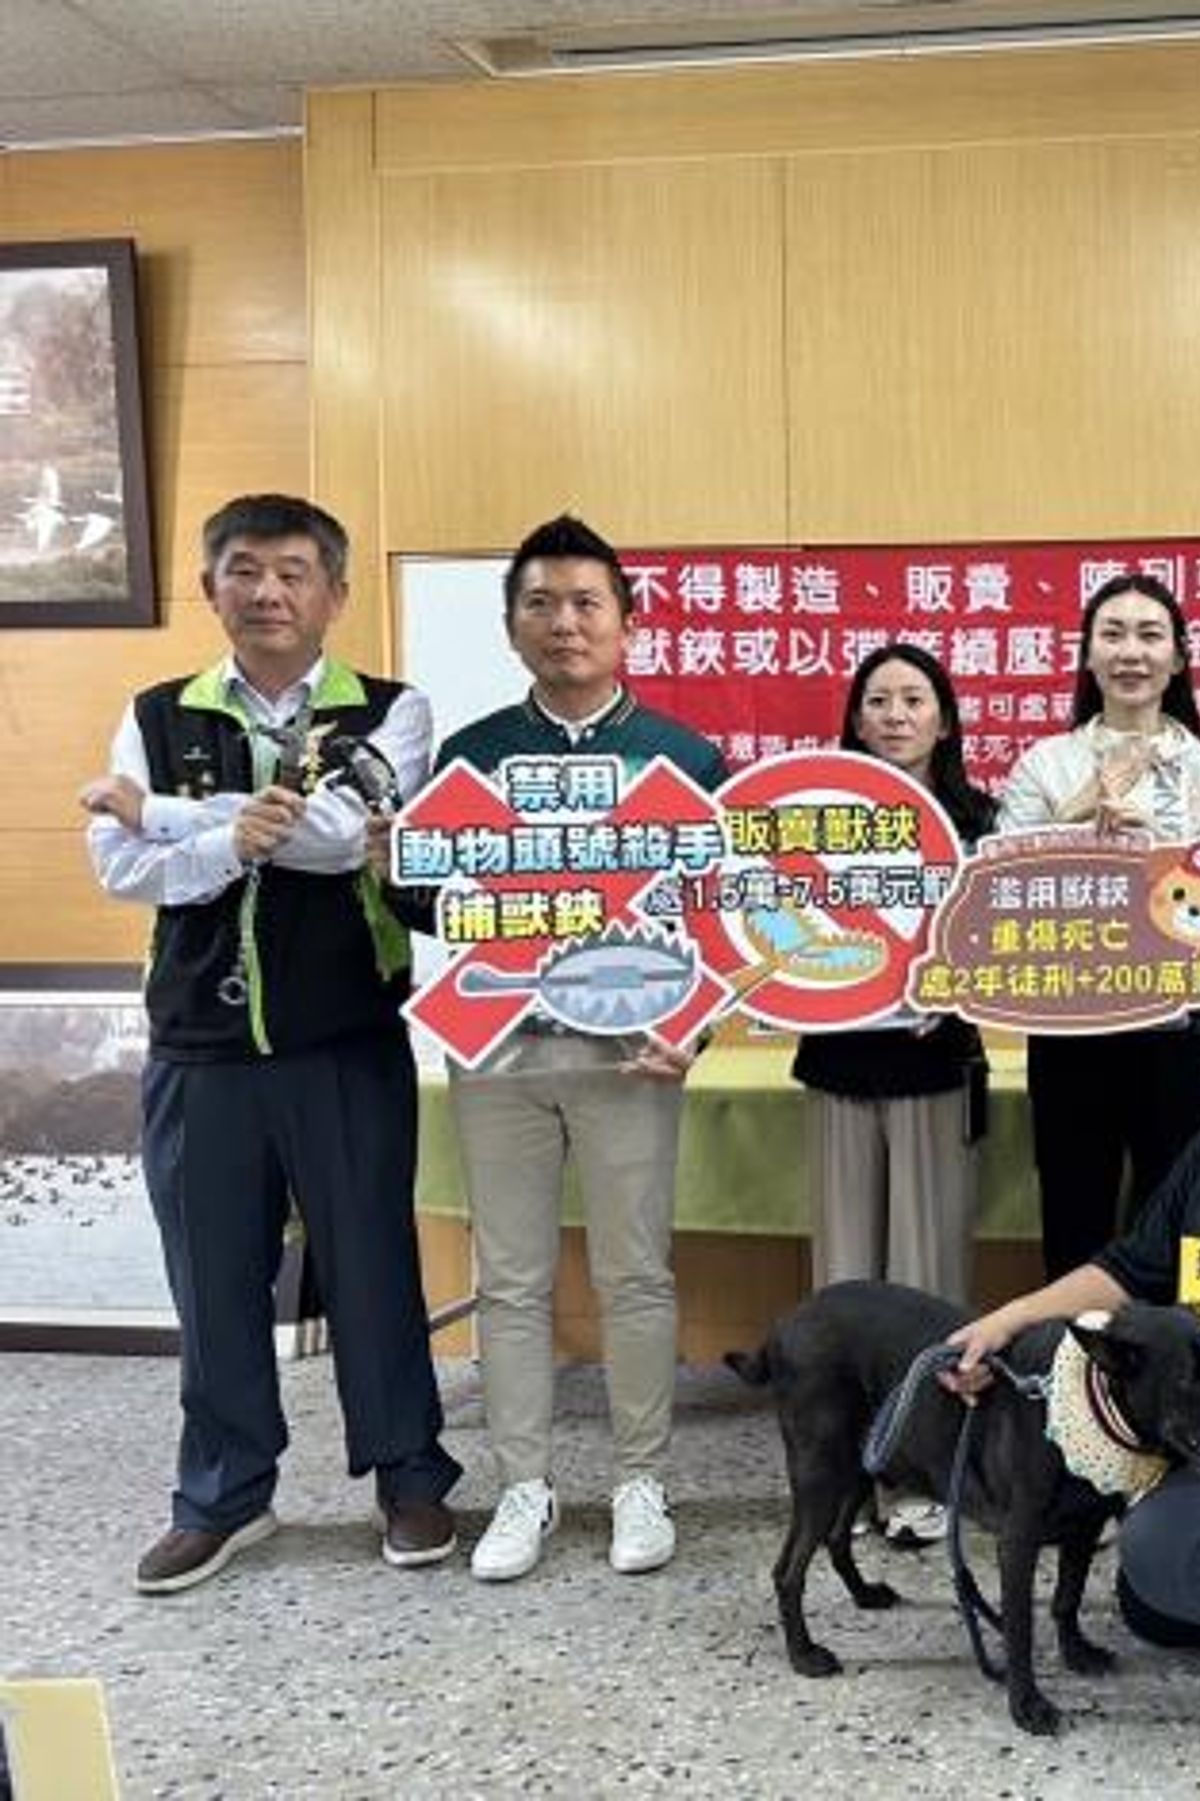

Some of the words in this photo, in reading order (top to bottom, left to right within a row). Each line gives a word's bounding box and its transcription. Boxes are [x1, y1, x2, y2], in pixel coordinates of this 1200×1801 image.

[509, 763, 617, 811] 禁用
[401, 824, 724, 877] 動物頭號殺手
[730, 806, 918, 853] 販賣獸鋏
[444, 890, 604, 941] 捕獸鋏
[990, 875, 1130, 909] 濫用獸鋏
